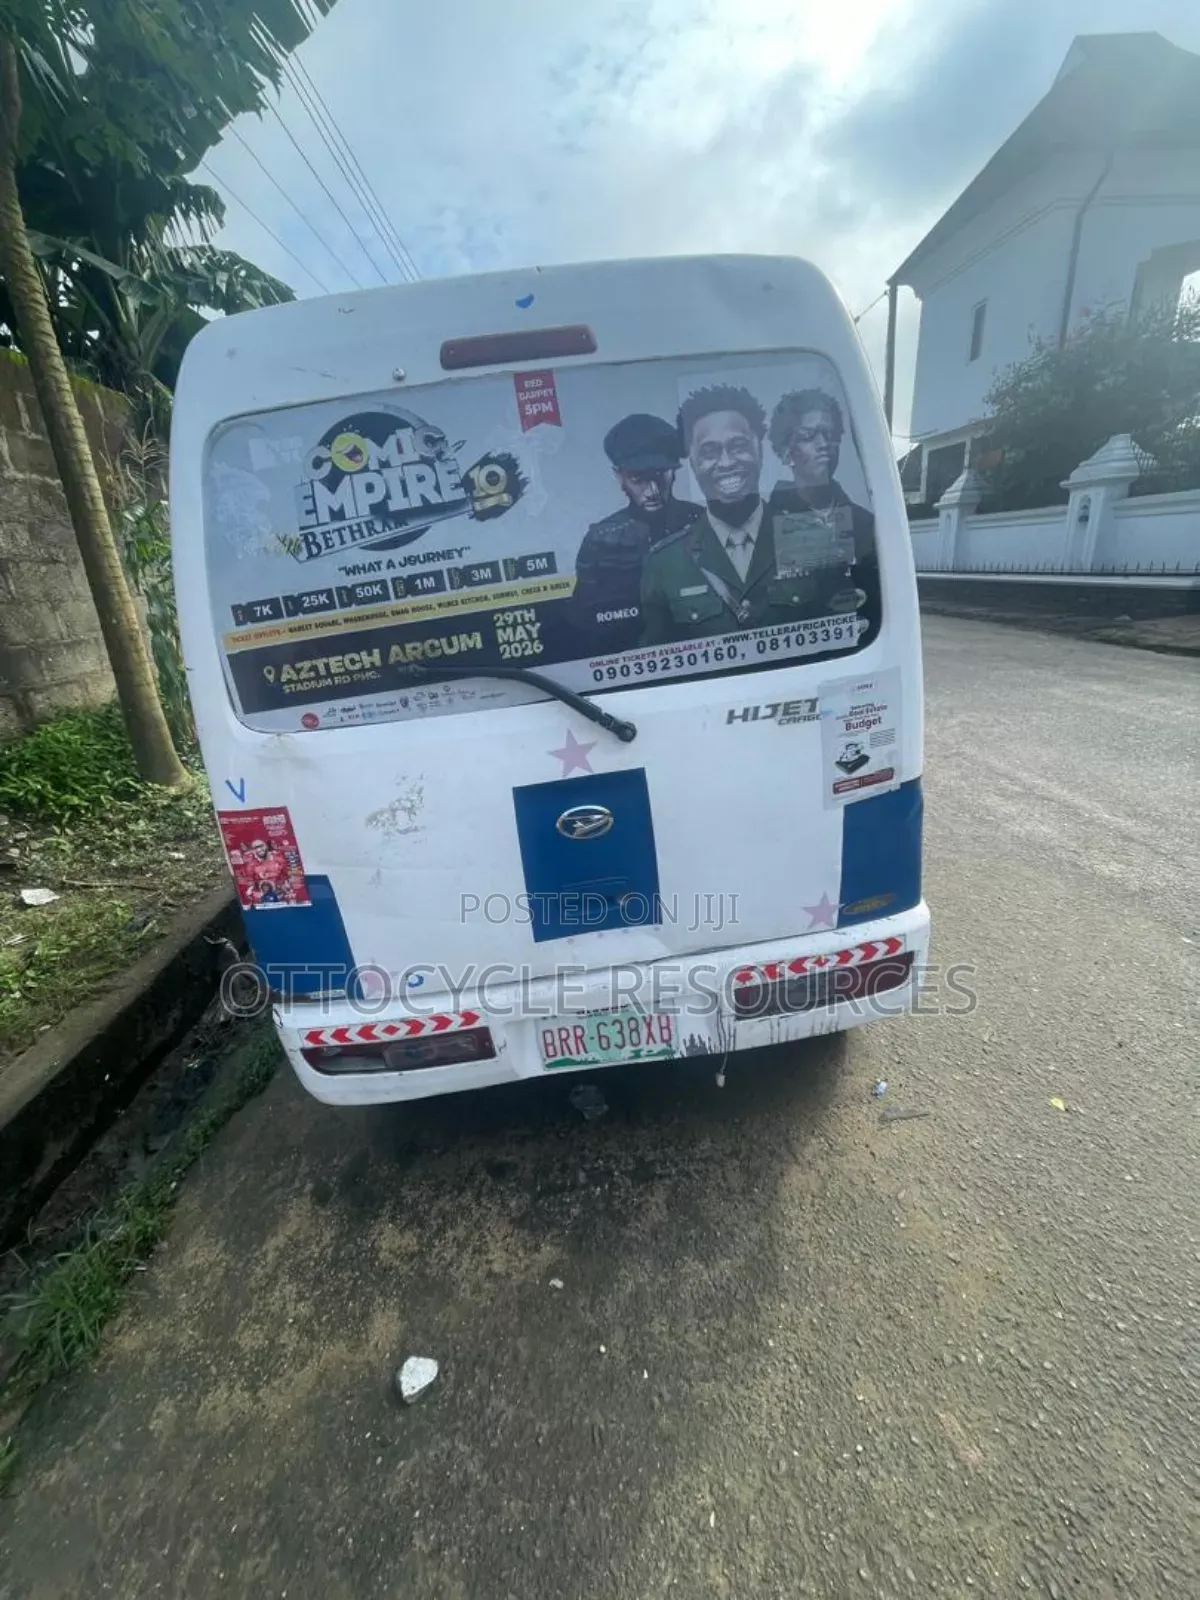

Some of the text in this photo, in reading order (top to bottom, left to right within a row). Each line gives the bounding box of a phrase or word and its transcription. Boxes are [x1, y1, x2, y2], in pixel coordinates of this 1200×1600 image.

[525, 401, 554, 416] 5PM
[294, 458, 467, 530] EMPIRE
[386, 559, 397, 571] A
[253, 604, 273, 617] 7K
[302, 593, 330, 608] 25K
[356, 583, 383, 598] 50K
[414, 576, 436, 591] 1M
[471, 567, 493, 582] 3M
[526, 557, 548, 571] 5M
[493, 608, 536, 627] 29TH
[596, 607, 639, 623] ROMEO
[496, 622, 541, 644] MAY
[589, 657, 619, 668] ONLINE
[621, 650, 657, 662] TICKETS
[659, 642, 705, 656] AVAILABLE
[722, 615, 859, 644] WWW.TELLERAFRICATICKE
[280, 632, 483, 682] AZTECH ARCUM
[500, 640, 544, 660] 2026
[593, 645, 746, 682] 09039230160,
[282, 677, 333, 694] STADIUM
[334, 674, 351, 686] RD
[726, 697, 819, 725] HIJET
[846, 716, 881, 731] Budget
[542, 1012, 673, 1059] BRR-638XB
